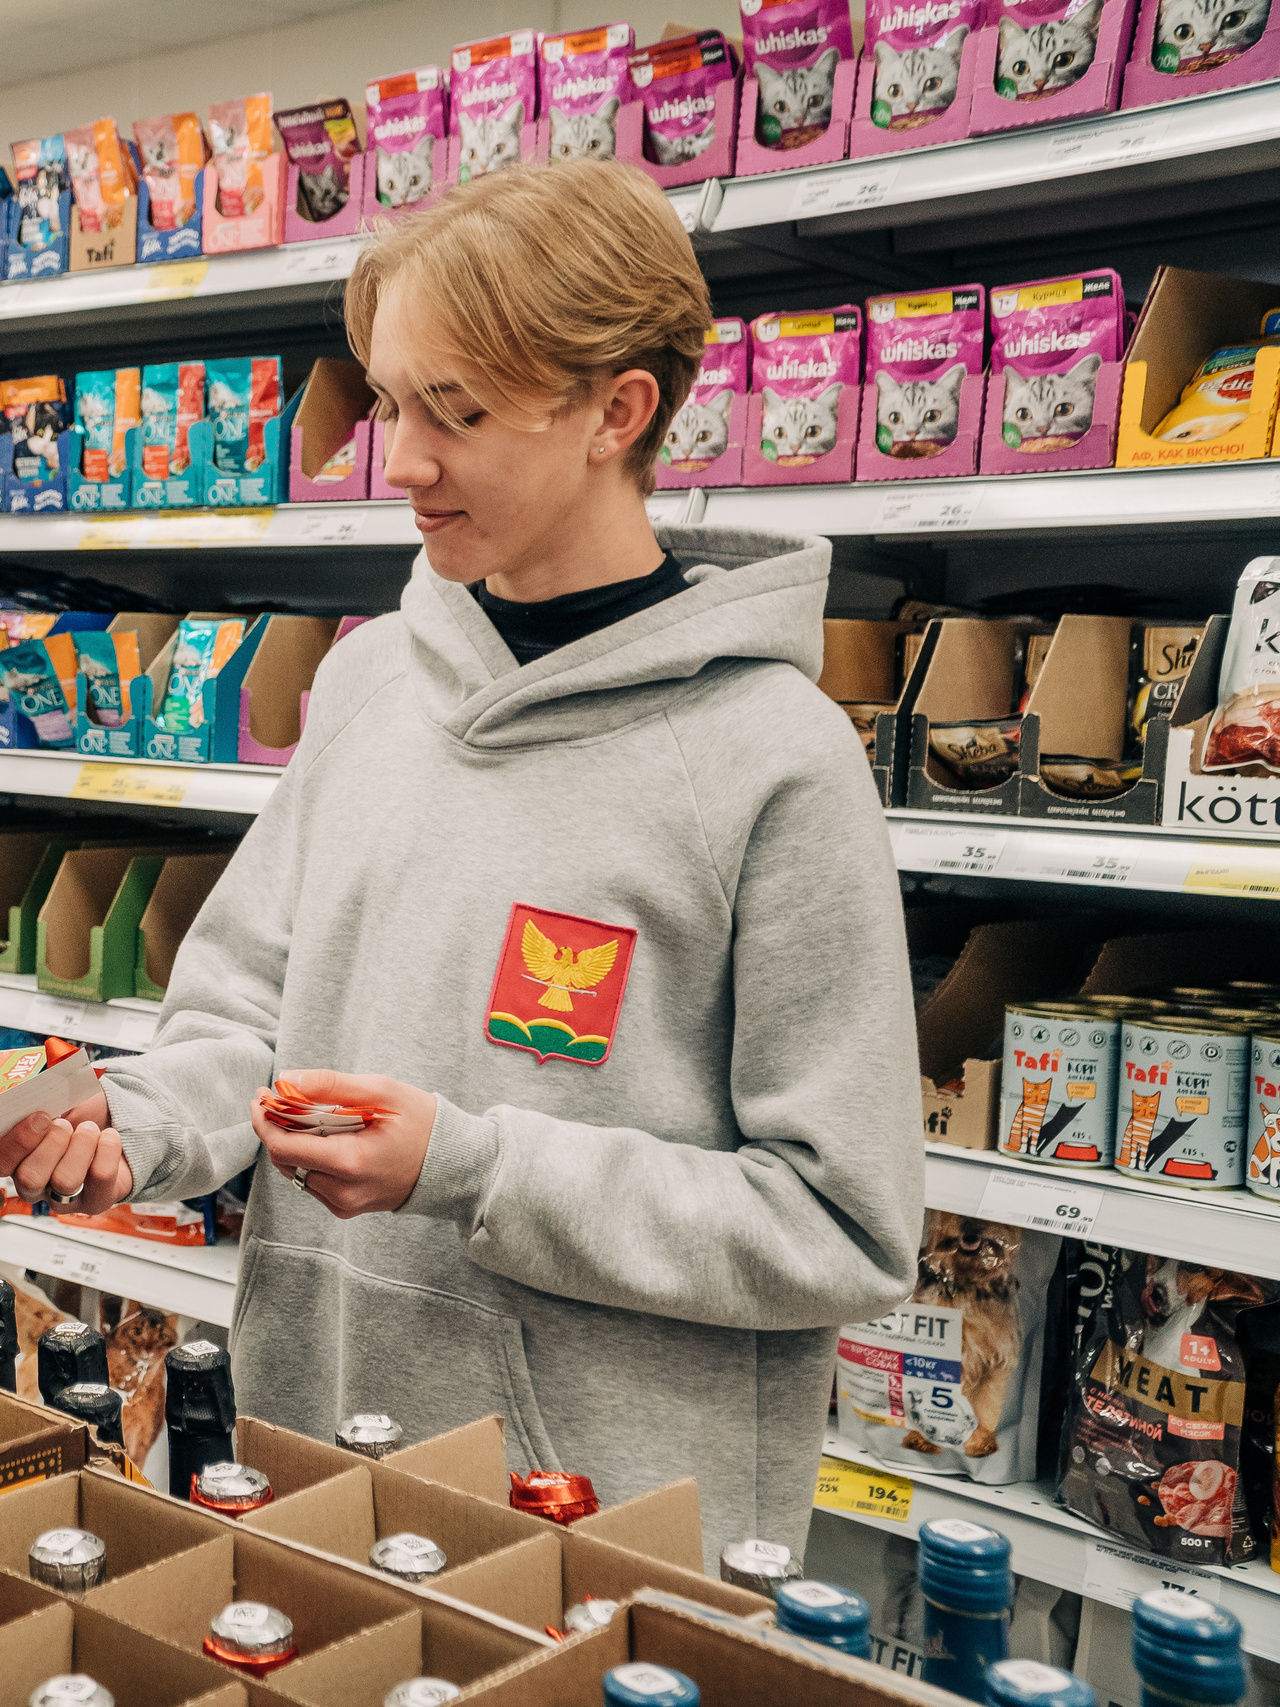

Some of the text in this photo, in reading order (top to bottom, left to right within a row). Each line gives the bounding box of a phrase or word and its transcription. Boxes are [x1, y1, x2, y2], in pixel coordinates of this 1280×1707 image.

[880, 0, 961, 35] whiskas
[754, 26, 828, 54] whiskas
[461, 81, 518, 108] whiskas
[553, 73, 613, 101] whiskas
[649, 95, 715, 124] whiskas
[373, 115, 427, 140] whiskas
[86, 243, 115, 264] Tafi
[881, 339, 958, 363] whiskas
[1004, 330, 1091, 358] whiskas
[767, 356, 837, 381] whiskas
[1132, 444, 1244, 463] АФ, КАК ВКУСНО!
[20, 689, 64, 714] ONE
[90, 684, 120, 706] ONE
[947, 742, 999, 760] Sheba
[1014, 1049, 1061, 1073] Tafi
[1067, 1061, 1097, 1074] КОРМ
[1125, 1061, 1170, 1086] Tafi
[1176, 1075, 1210, 1088] КОРМ
[923, 1111, 949, 1136] fi
[914, 1314, 950, 1339] FIT
[1189, 1341, 1210, 1356] 1+
[865, 1356, 900, 1371] СОБАК
[1118, 1355, 1209, 1414] MEAT
[930, 1386, 954, 1409] 5
[868, 1485, 898, 1502] 194
[1180, 1537, 1202, 1548] 500
